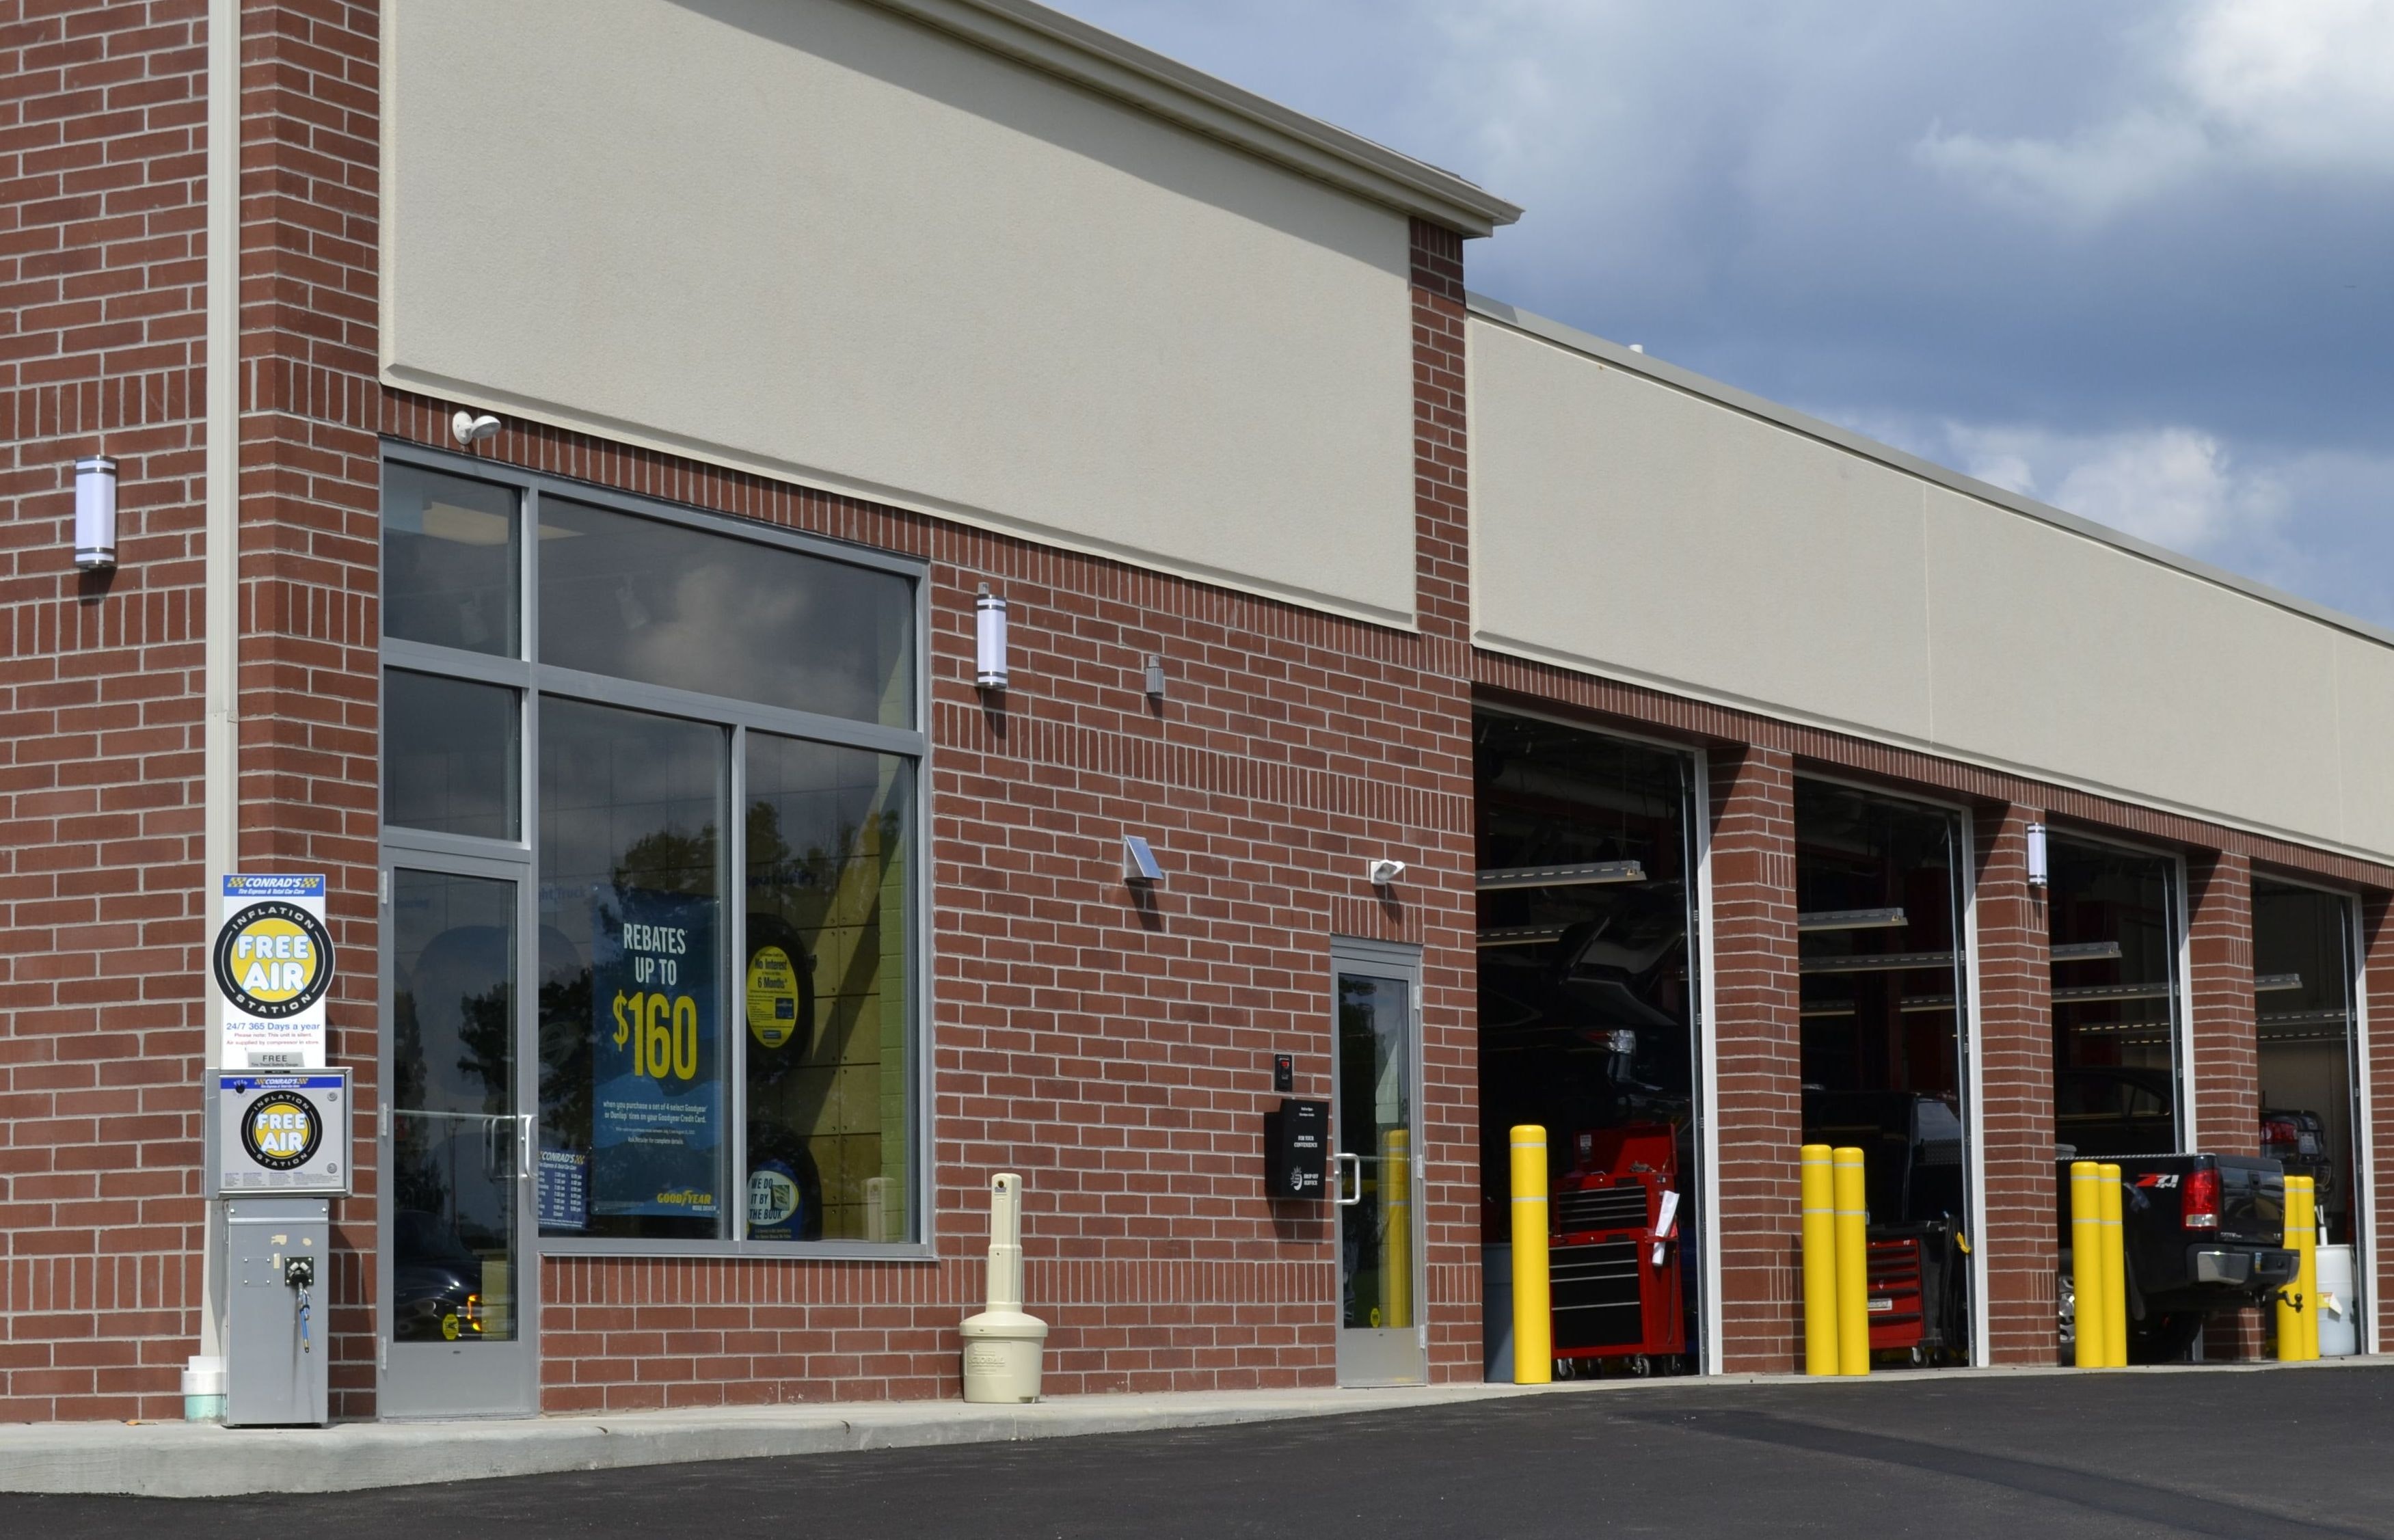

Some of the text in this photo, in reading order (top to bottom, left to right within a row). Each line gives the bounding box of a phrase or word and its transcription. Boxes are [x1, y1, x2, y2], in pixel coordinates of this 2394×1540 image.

[245, 878, 302, 888] CONRAD'S
[232, 906, 314, 930] INFLATION
[238, 935, 310, 959] FREE
[755, 957, 788, 970] No Interest
[242, 962, 305, 991] AIR
[635, 956, 677, 986] UP TO
[757, 977, 762, 988] 6
[236, 995, 311, 1014] STATION
[267, 1023, 290, 1031] Days
[613, 989, 697, 1080] $160
[254, 1094, 309, 1111] INFLATION
[617, 1102, 626, 1110] you
[626, 1101, 647, 1110] purchase
[670, 1103, 684, 1111] select
[256, 1113, 306, 1129] FREE
[647, 1114, 657, 1122] your
[658, 1113, 680, 1124] Goodyear
[680, 1114, 694, 1122] Credit
[260, 1132, 304, 1152] AIR
[256, 1153, 308, 1167] STATION
[542, 1151, 575, 1163] CONRAD'S
[751, 1178, 773, 1189] WE DO
[2135, 1174, 2180, 1187] Z71
[657, 1190, 712, 1206] GOODYEAR
[751, 1193, 768, 1204] IT BY
[749, 1208, 783, 1220] THE BOOK
